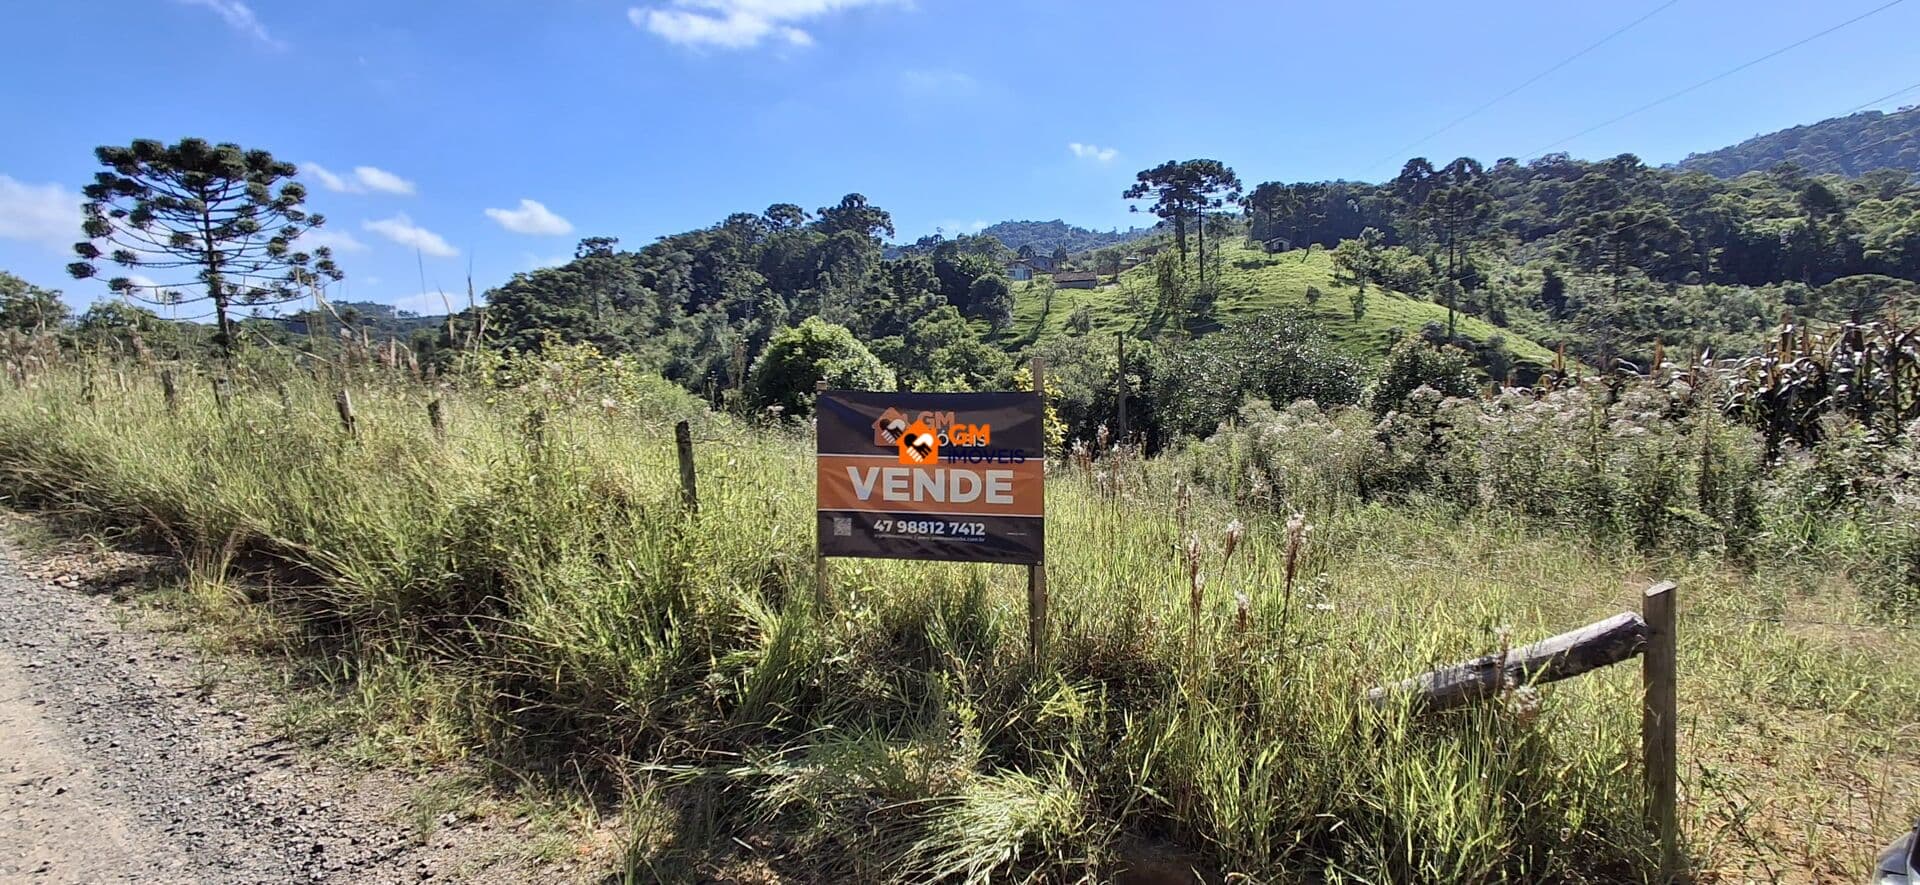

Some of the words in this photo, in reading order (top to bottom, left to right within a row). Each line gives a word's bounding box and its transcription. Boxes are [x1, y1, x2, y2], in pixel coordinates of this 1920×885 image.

[918, 411, 955, 429] GM
[847, 466, 1014, 504] VENDE
[873, 519, 893, 532] 47
[897, 520, 945, 534] 98812
[949, 522, 986, 536] 7412
